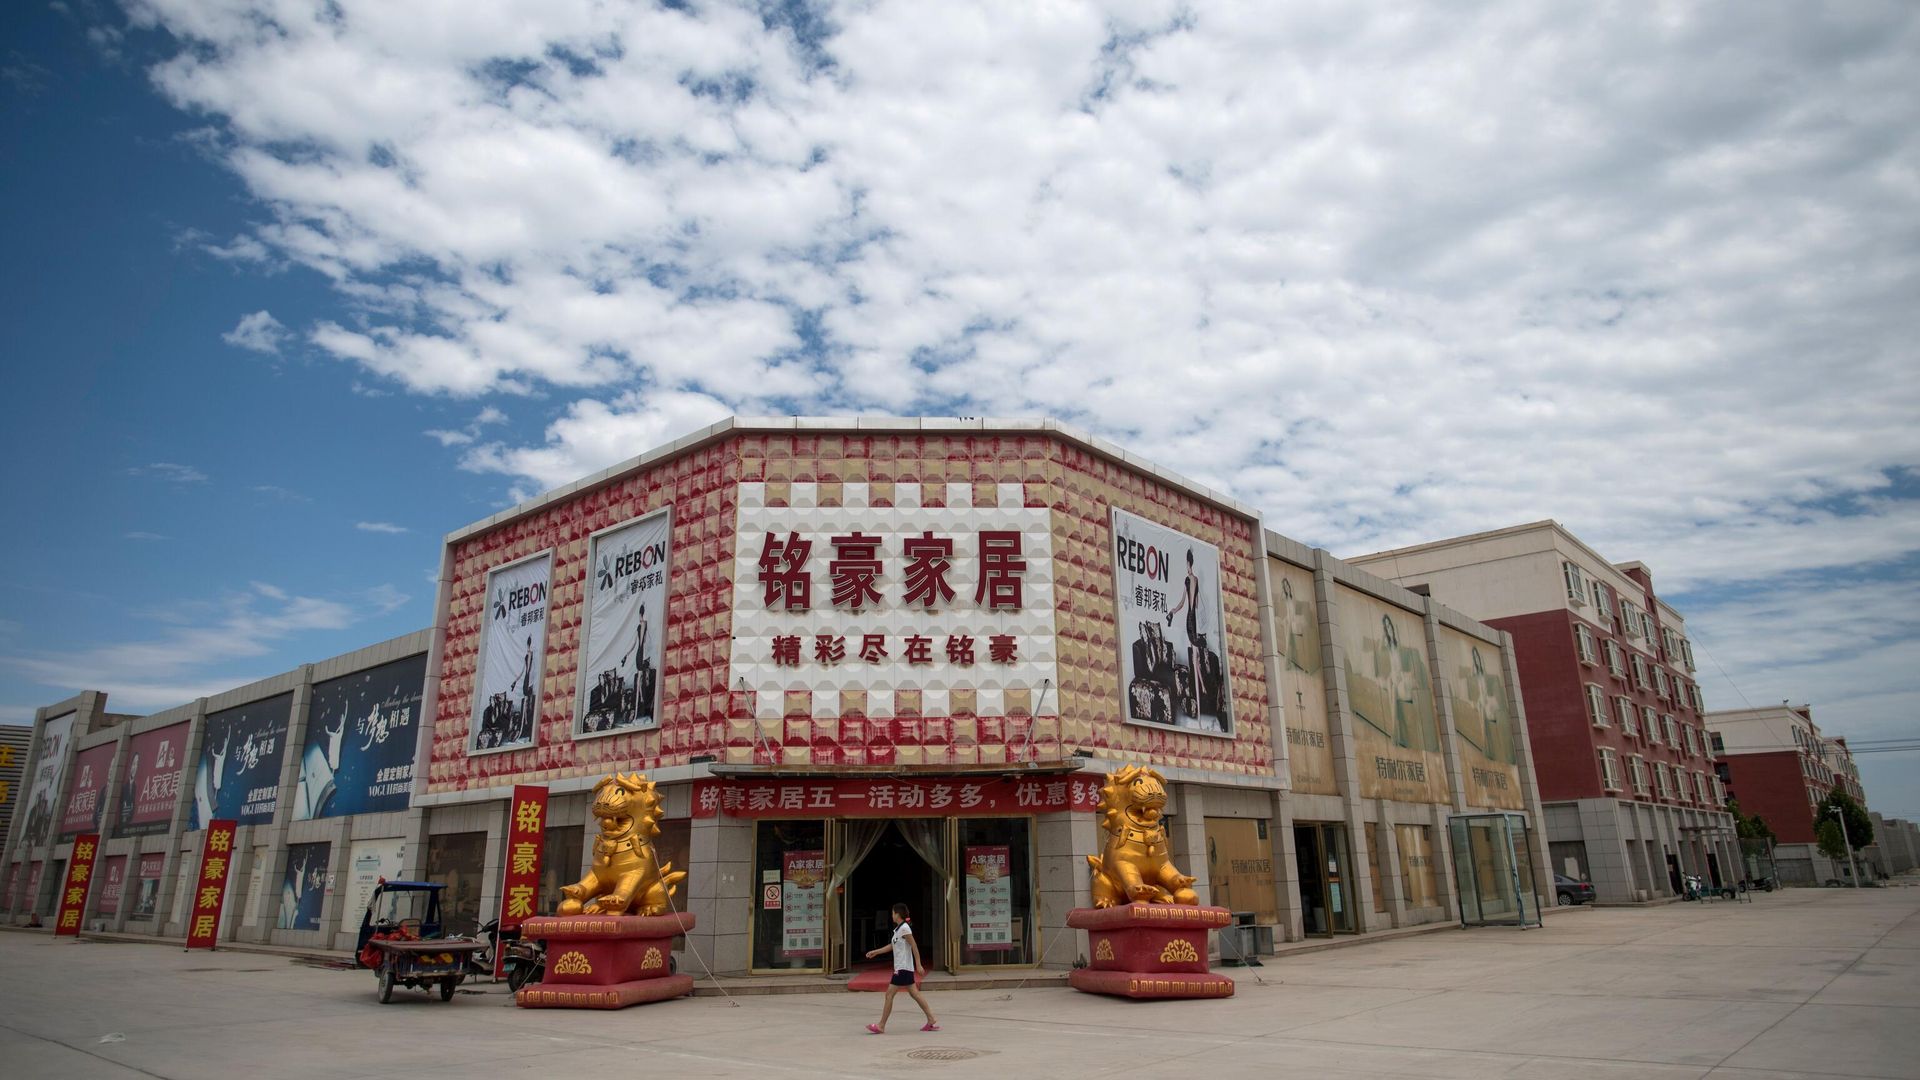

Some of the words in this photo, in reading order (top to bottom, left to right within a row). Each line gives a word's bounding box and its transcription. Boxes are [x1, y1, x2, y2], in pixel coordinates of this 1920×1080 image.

[615, 541, 666, 579] REBON
[758, 531, 1027, 609] 铭豪家居
[1117, 535, 1169, 583] REBON
[509, 580, 548, 611] REBON
[631, 570, 663, 595] 睿邦家私
[1135, 584, 1168, 613] 睿邦家私
[772, 634, 1018, 665] 精彩尽在铭豪
[356, 703, 411, 751] 与梦想相遇
[1376, 756, 1425, 783] 特耐尔家居
[508, 800, 542, 920] 铭豪家
[61, 842, 95, 928] 铭豪家居
[193, 829, 232, 938] 铭豪家居
